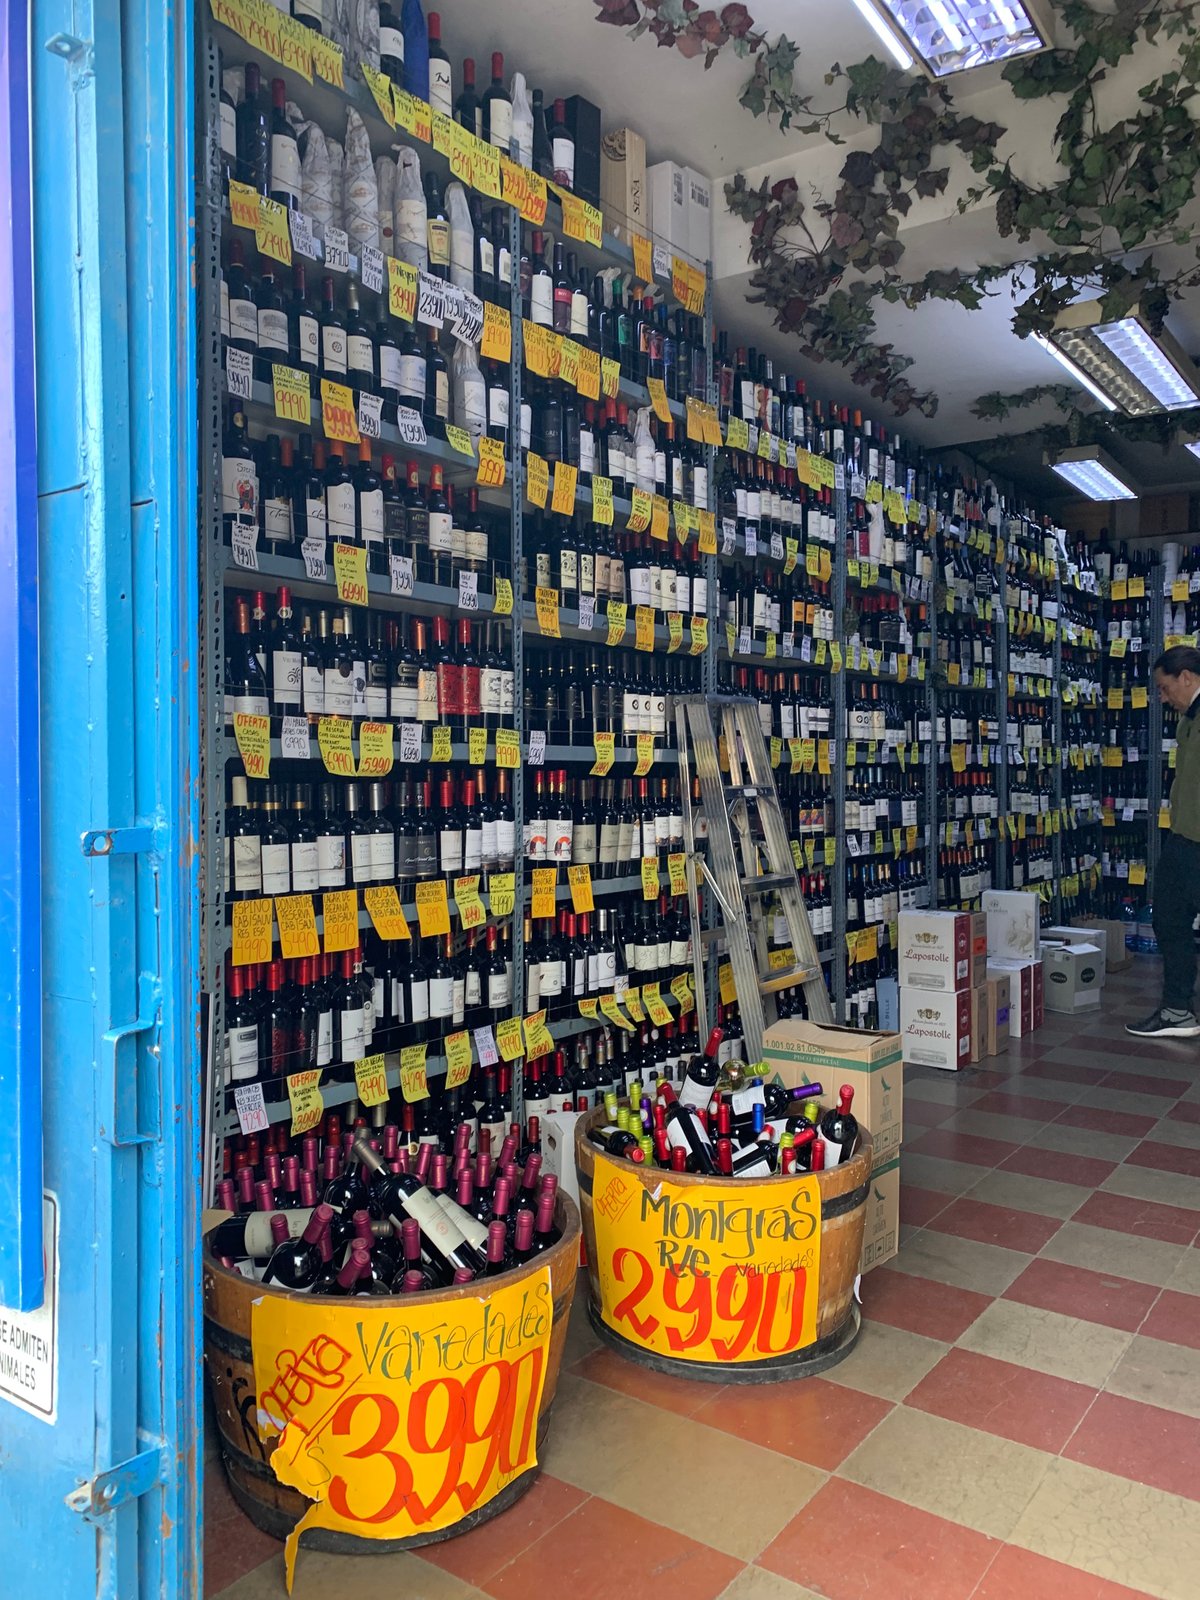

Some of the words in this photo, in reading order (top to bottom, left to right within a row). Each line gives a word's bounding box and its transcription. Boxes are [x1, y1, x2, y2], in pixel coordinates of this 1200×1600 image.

[275, 389, 307, 421] 9990
[237, 714, 268, 730] OFERTA
[319, 718, 333, 727] CASA
[362, 722, 387, 734] OFERTA
[276, 897, 290, 911] DON
[342, 890, 352, 902] DE
[369, 897, 397, 909] RESERVA
[234, 899, 271, 914] ESPINO
[281, 907, 311, 921] RESERVA
[238, 928, 250, 939] RES
[253, 926, 265, 938] ESP
[325, 922, 357, 947] 5990
[234, 937, 269, 961] 4990
[284, 931, 317, 956] 5490
[904, 948, 950, 963] Lapostolle
[905, 1024, 951, 1040] Lapostolle
[370, 1055, 384, 1066] NEGRA
[793, 1054, 812, 1063] PISCO
[813, 1056, 840, 1066] ESPECIAL
[290, 1072, 318, 1088] OFERTA
[359, 1074, 386, 1101] 3490
[242, 1108, 267, 1131] 4290
[735, 1248, 815, 1278] variedades
[356, 1282, 551, 1386] Variedades
[10, 1324, 48, 1363] ADMITEN
[0, 1351, 36, 1390] NIMALES
